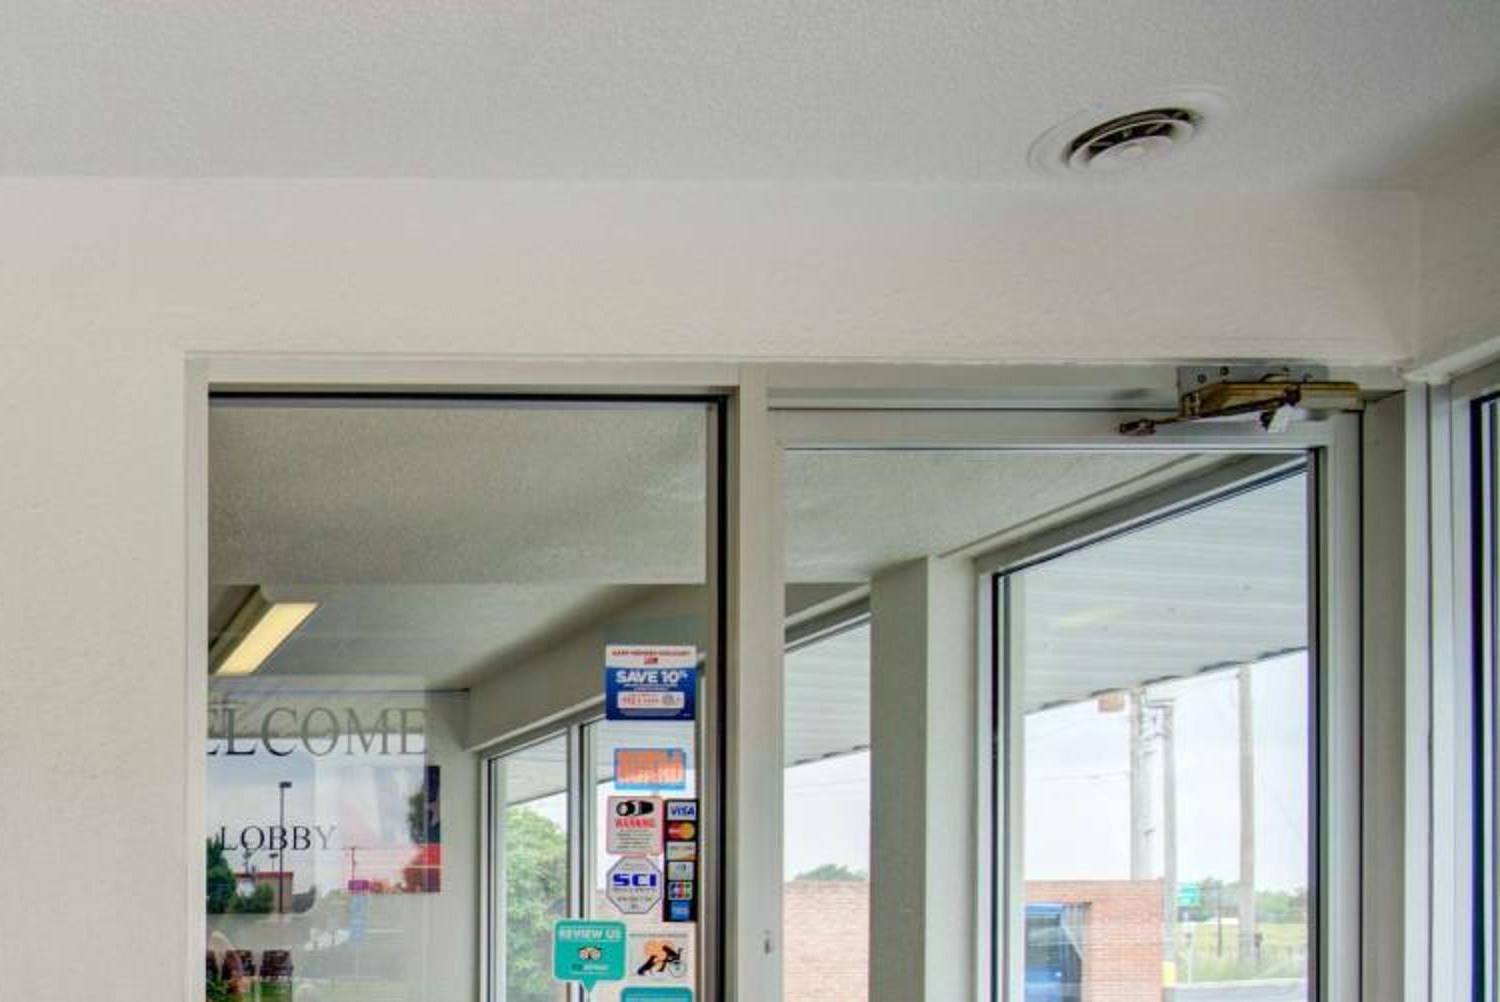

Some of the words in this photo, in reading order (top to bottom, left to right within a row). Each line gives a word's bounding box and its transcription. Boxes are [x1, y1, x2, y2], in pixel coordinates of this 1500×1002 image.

[615, 669, 658, 684] SAVE
[670, 806, 695, 817] VISA
[218, 825, 337, 851] LOBBY
[612, 873, 657, 887] SCI
